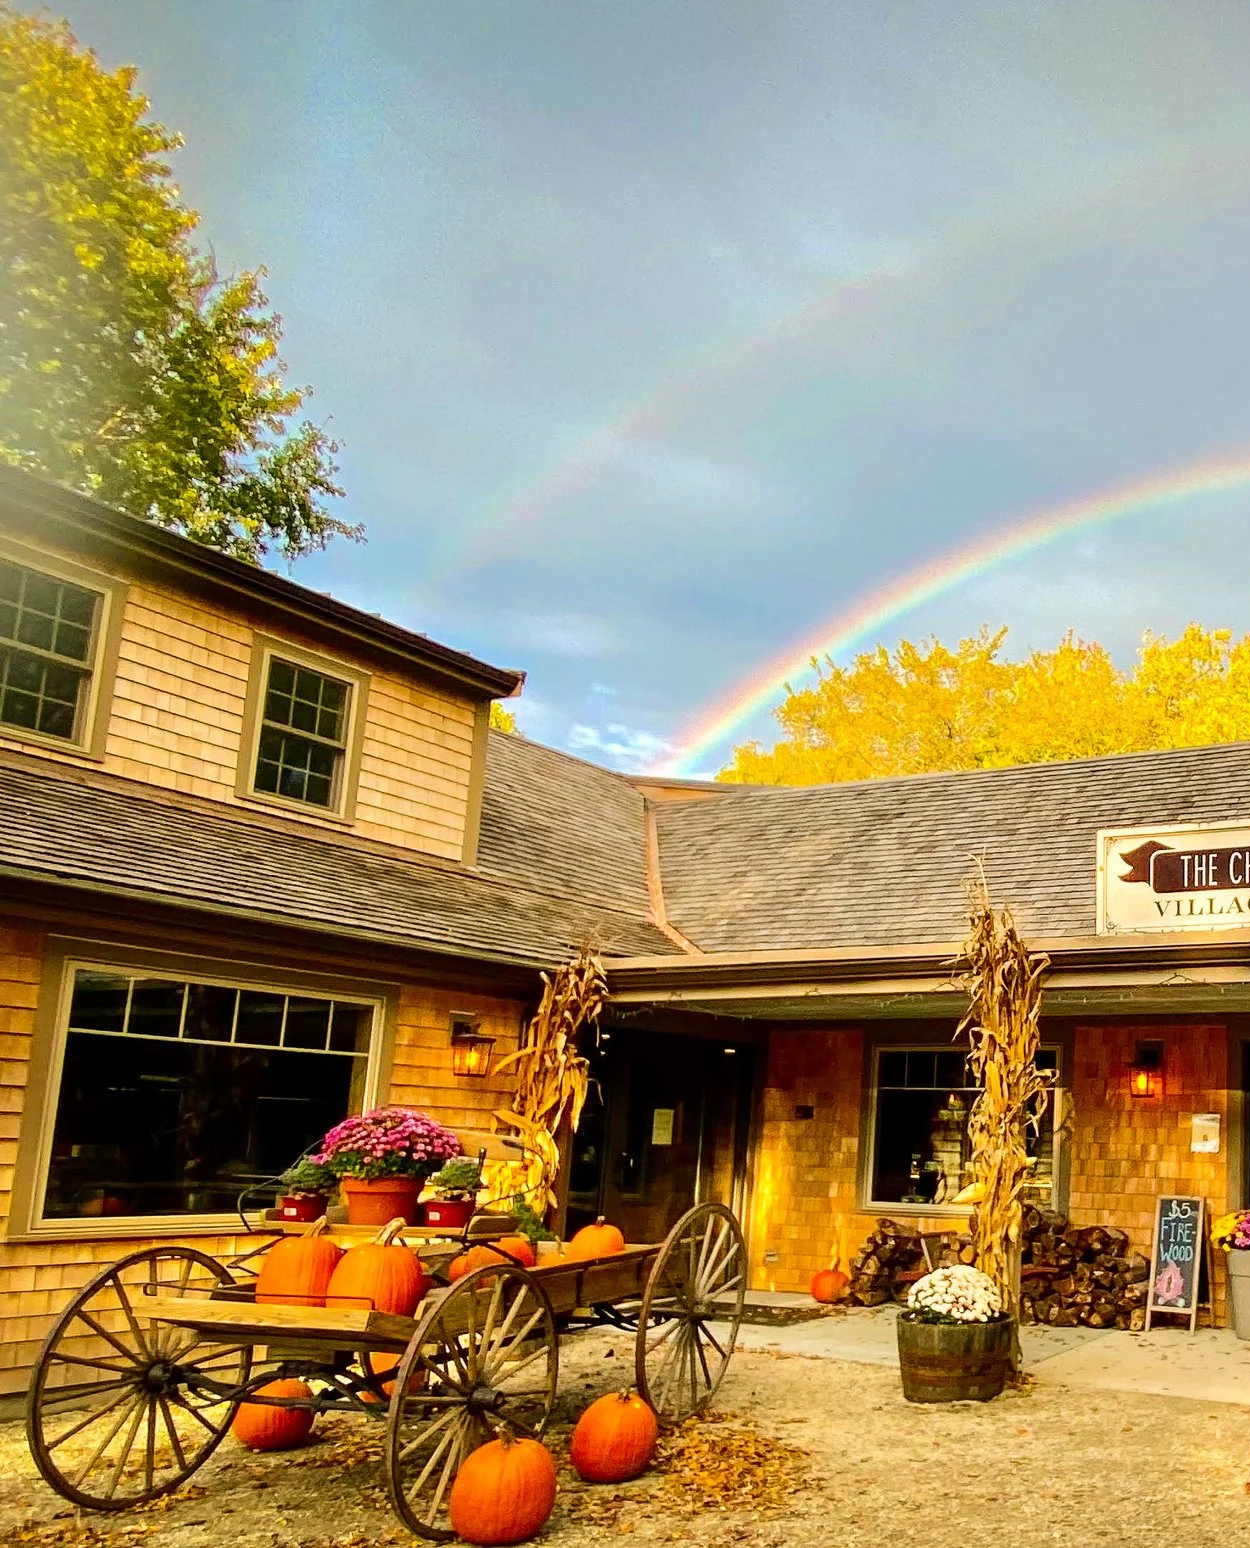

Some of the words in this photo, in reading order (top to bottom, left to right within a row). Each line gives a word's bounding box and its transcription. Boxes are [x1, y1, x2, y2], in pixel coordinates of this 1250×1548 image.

[1180, 853, 1218, 887] THE
[1168, 1200, 1191, 1218] $5
[1160, 1243, 1193, 1262] WOOD
